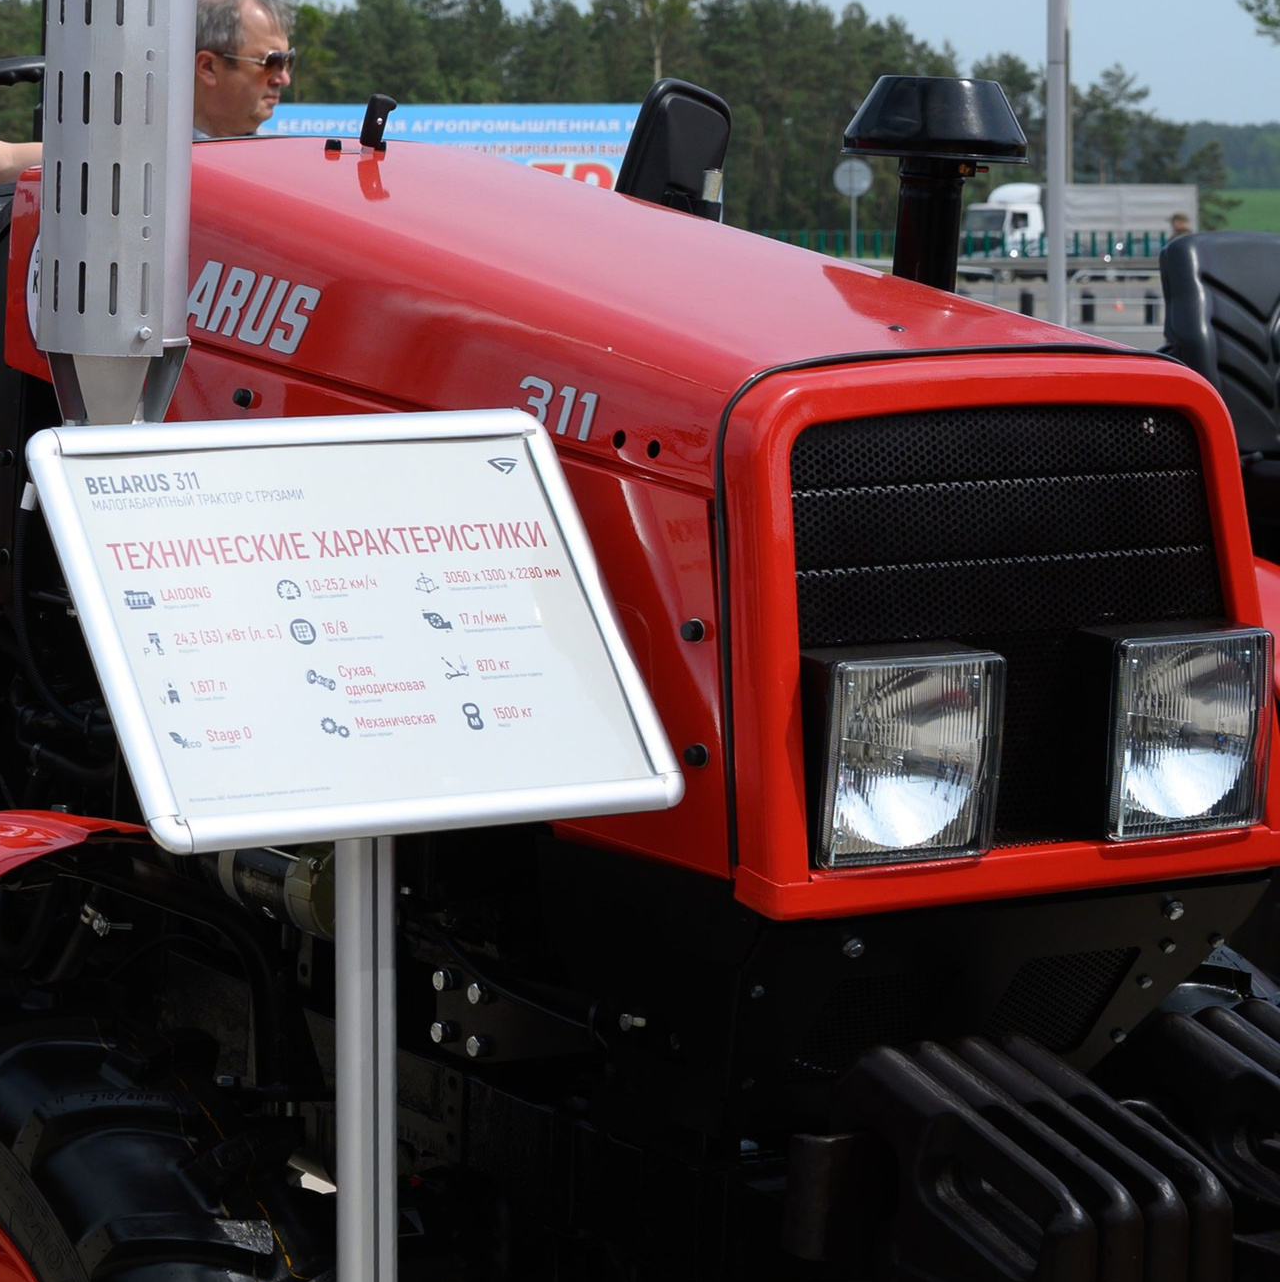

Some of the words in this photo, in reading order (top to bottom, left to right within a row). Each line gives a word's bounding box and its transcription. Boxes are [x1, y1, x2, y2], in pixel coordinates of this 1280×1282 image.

[411, 118, 619, 134] АГРОПРОМЫШЛЕННАЯ
[519, 375, 598, 441] 311
[84, 473, 170, 495] BELARUS
[173, 472, 200, 491] 311
[91, 492, 194, 512] МАЛОГАБАРИТНЫЙ
[197, 490, 243, 506] ТРАКТОР
[255, 488, 306, 503] ГРУЗАМИ
[106, 532, 310, 571] ТЕХНИЧЕСКИЕ
[312, 521, 548, 558] ХАРАКТЕРИСТИКИ
[443, 570, 471, 584] 3050
[480, 569, 506, 582] 1300
[516, 567, 543, 579] 2280
[544, 568, 561, 578] мм
[305, 577, 348, 593] 1,0-25,2
[349, 575, 378, 590] км/ч
[160, 586, 211, 602] LAIDONG
[459, 613, 469, 625] 17
[472, 610, 507, 626] л/мин
[322, 619, 348, 635] 16/8
[173, 632, 198, 646] 24,3
[199, 628, 224, 645] (33)
[226, 629, 247, 642] кВт
[338, 665, 376, 680] Сухая,
[476, 659, 496, 672] 870
[498, 660, 510, 671] кг
[190, 680, 215, 695] 1,617
[345, 680, 426, 696] однодисковая
[493, 706, 519, 720] 1500
[521, 708, 532, 718] кг
[354, 713, 437, 730] Механическая
[206, 729, 241, 743] Stage
